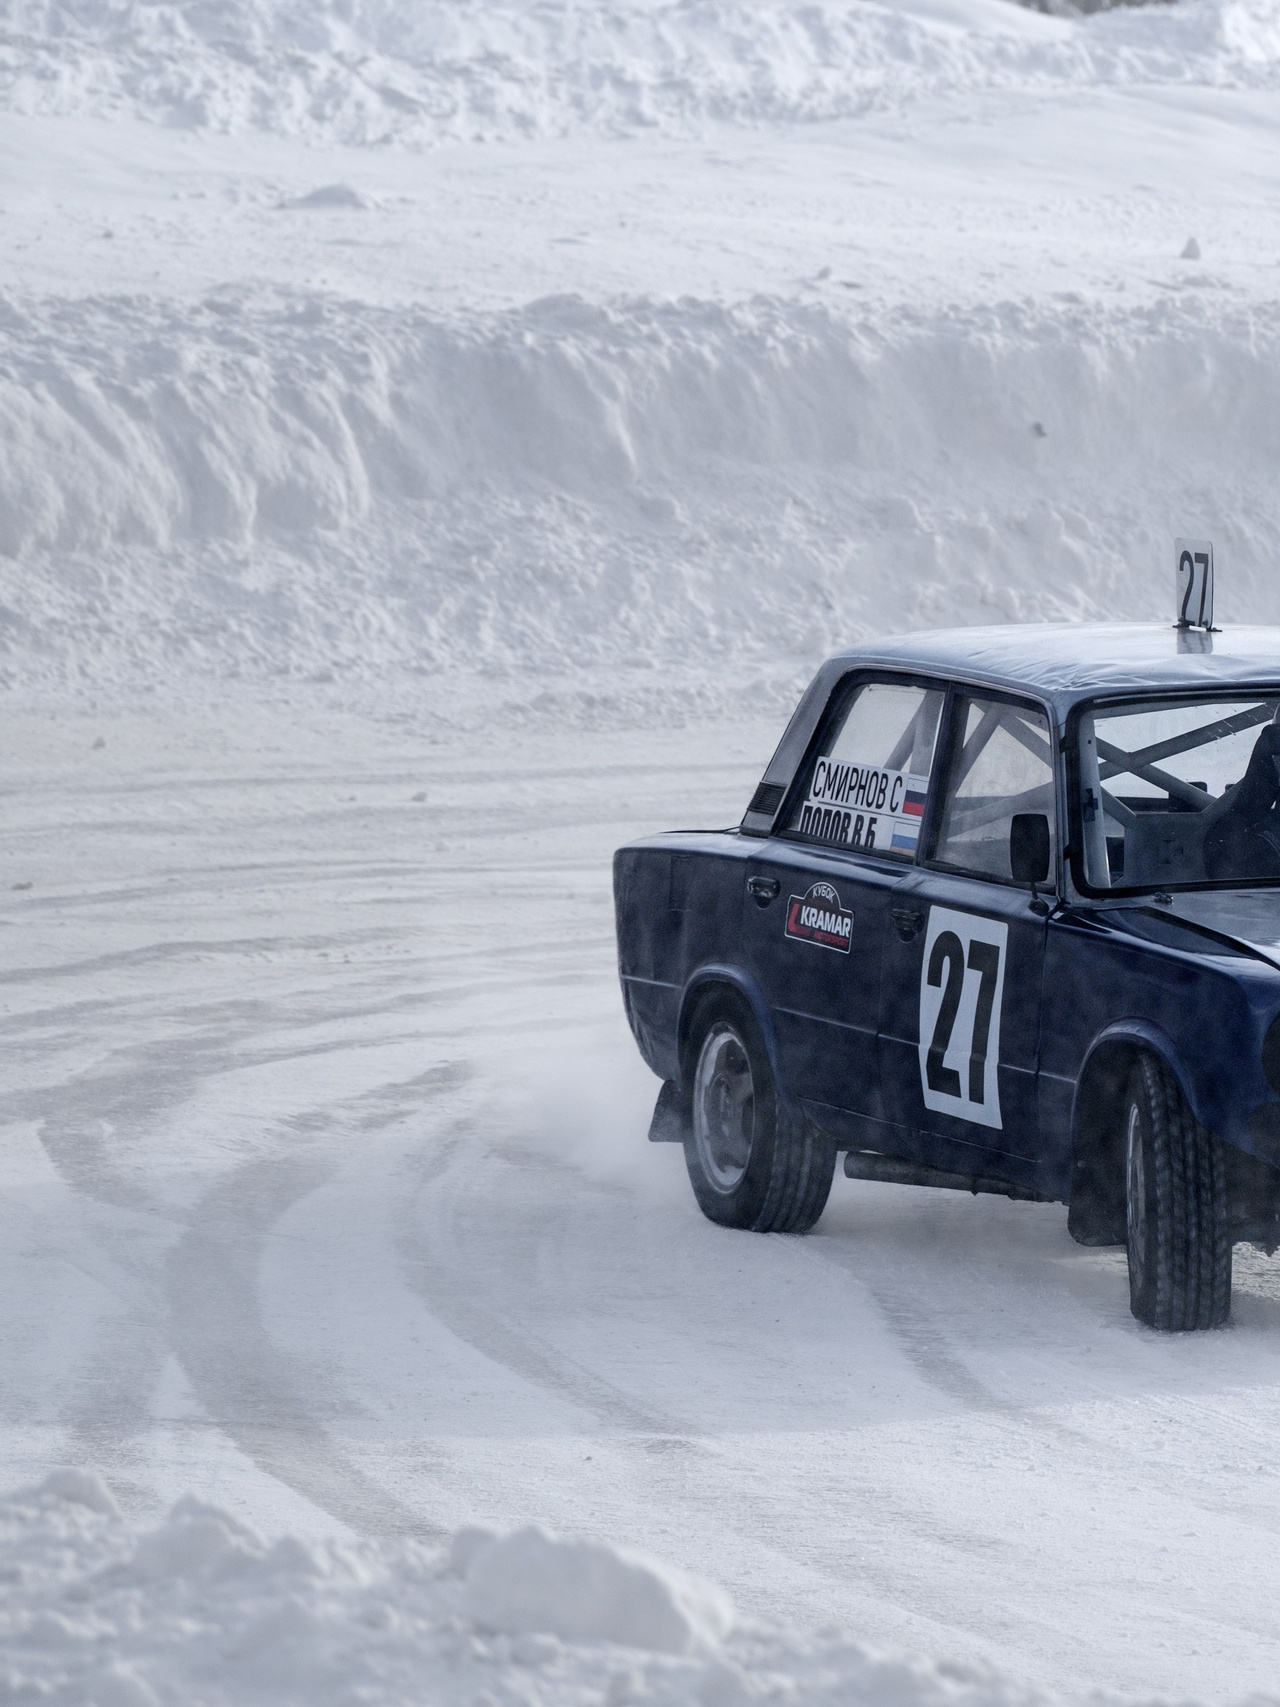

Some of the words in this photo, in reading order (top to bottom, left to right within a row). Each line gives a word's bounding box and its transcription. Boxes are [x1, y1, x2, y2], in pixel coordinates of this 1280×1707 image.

[1179, 550, 1209, 627] 27
[813, 760, 888, 810] СМИРНОВ
[890, 775, 903, 813] С
[800, 805, 852, 843] ПОПОВ
[812, 885, 836, 904] КУБОК
[800, 905, 851, 938] KRAMAR
[926, 930, 1000, 1105] 27
